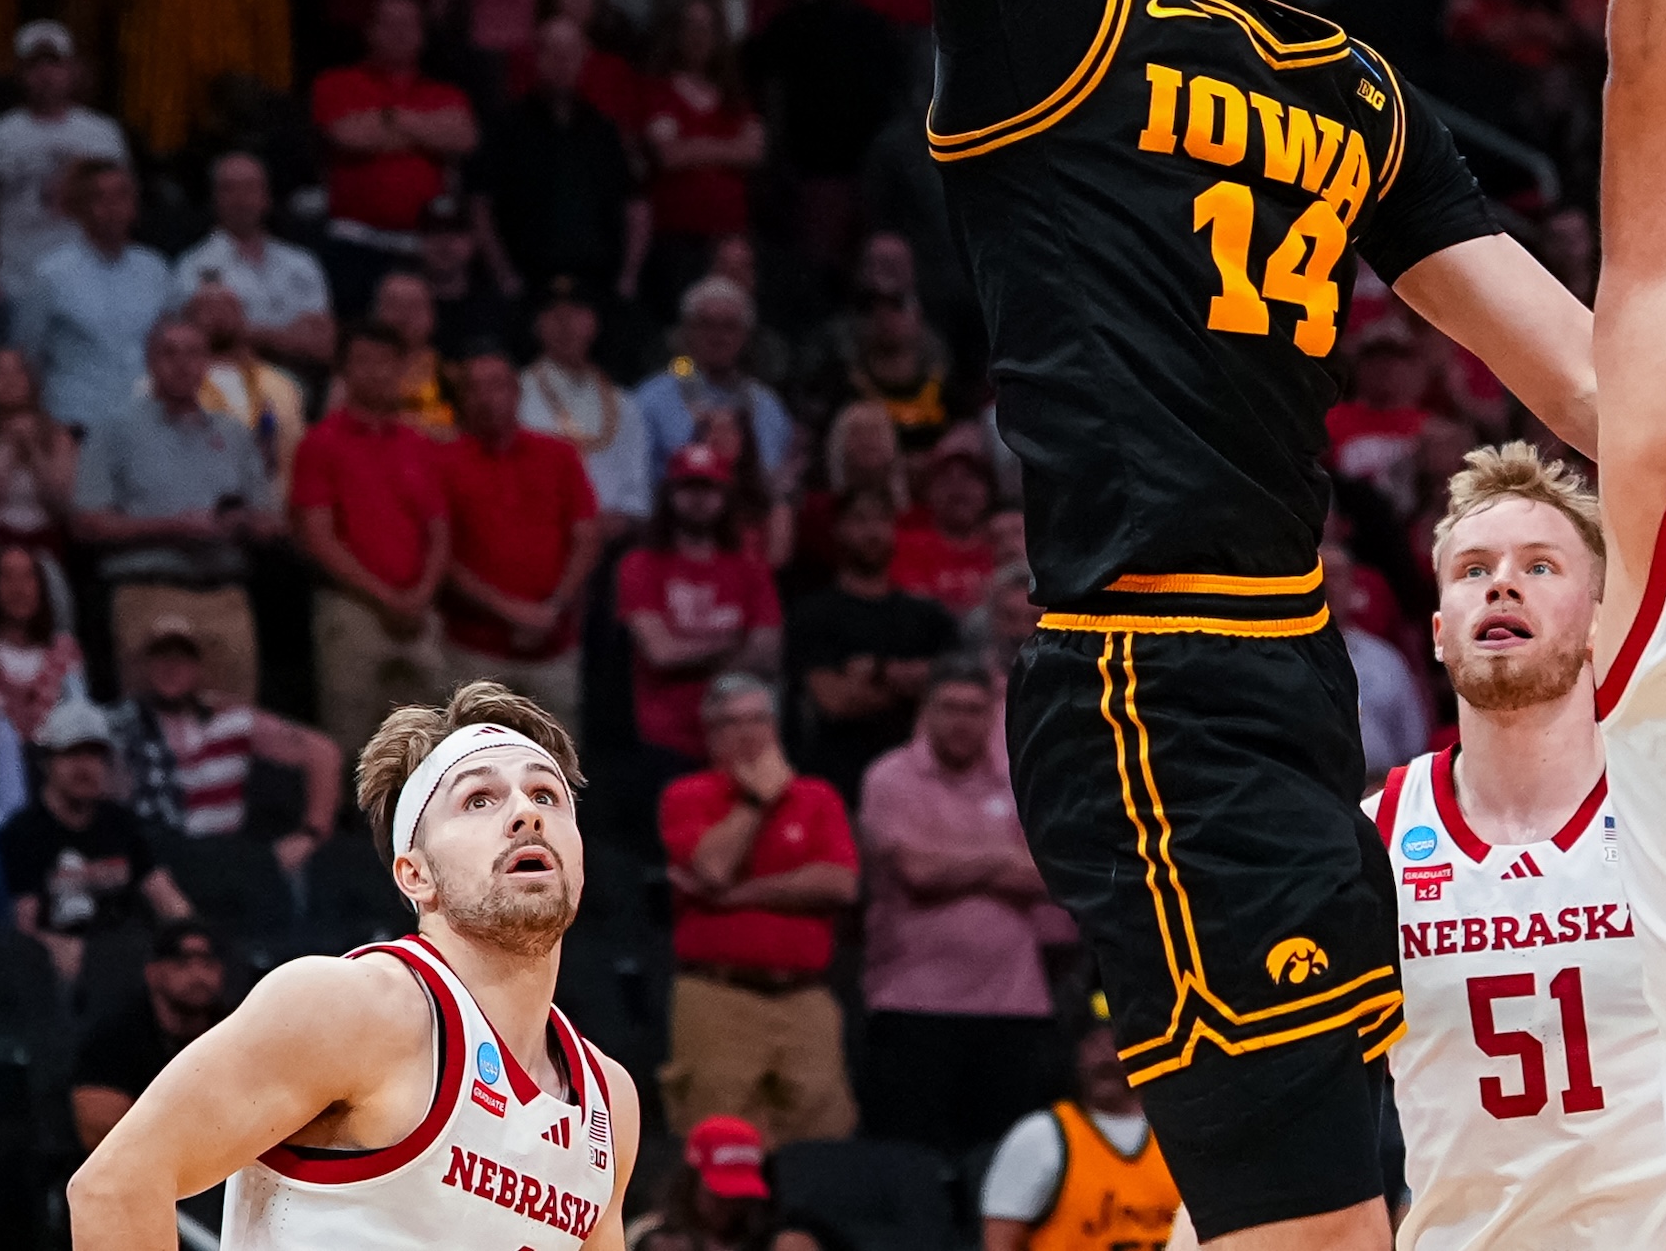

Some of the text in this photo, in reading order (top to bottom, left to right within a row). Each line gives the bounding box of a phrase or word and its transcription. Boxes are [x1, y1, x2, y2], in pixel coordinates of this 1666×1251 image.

[1137, 62, 1372, 228] IOWA
[1193, 181, 1346, 357] 14
[1404, 868, 1452, 880] GRADUATE
[1418, 884, 1439, 899] x2
[1466, 966, 1605, 1120] 51
[473, 1087, 505, 1113] GRADUATE
